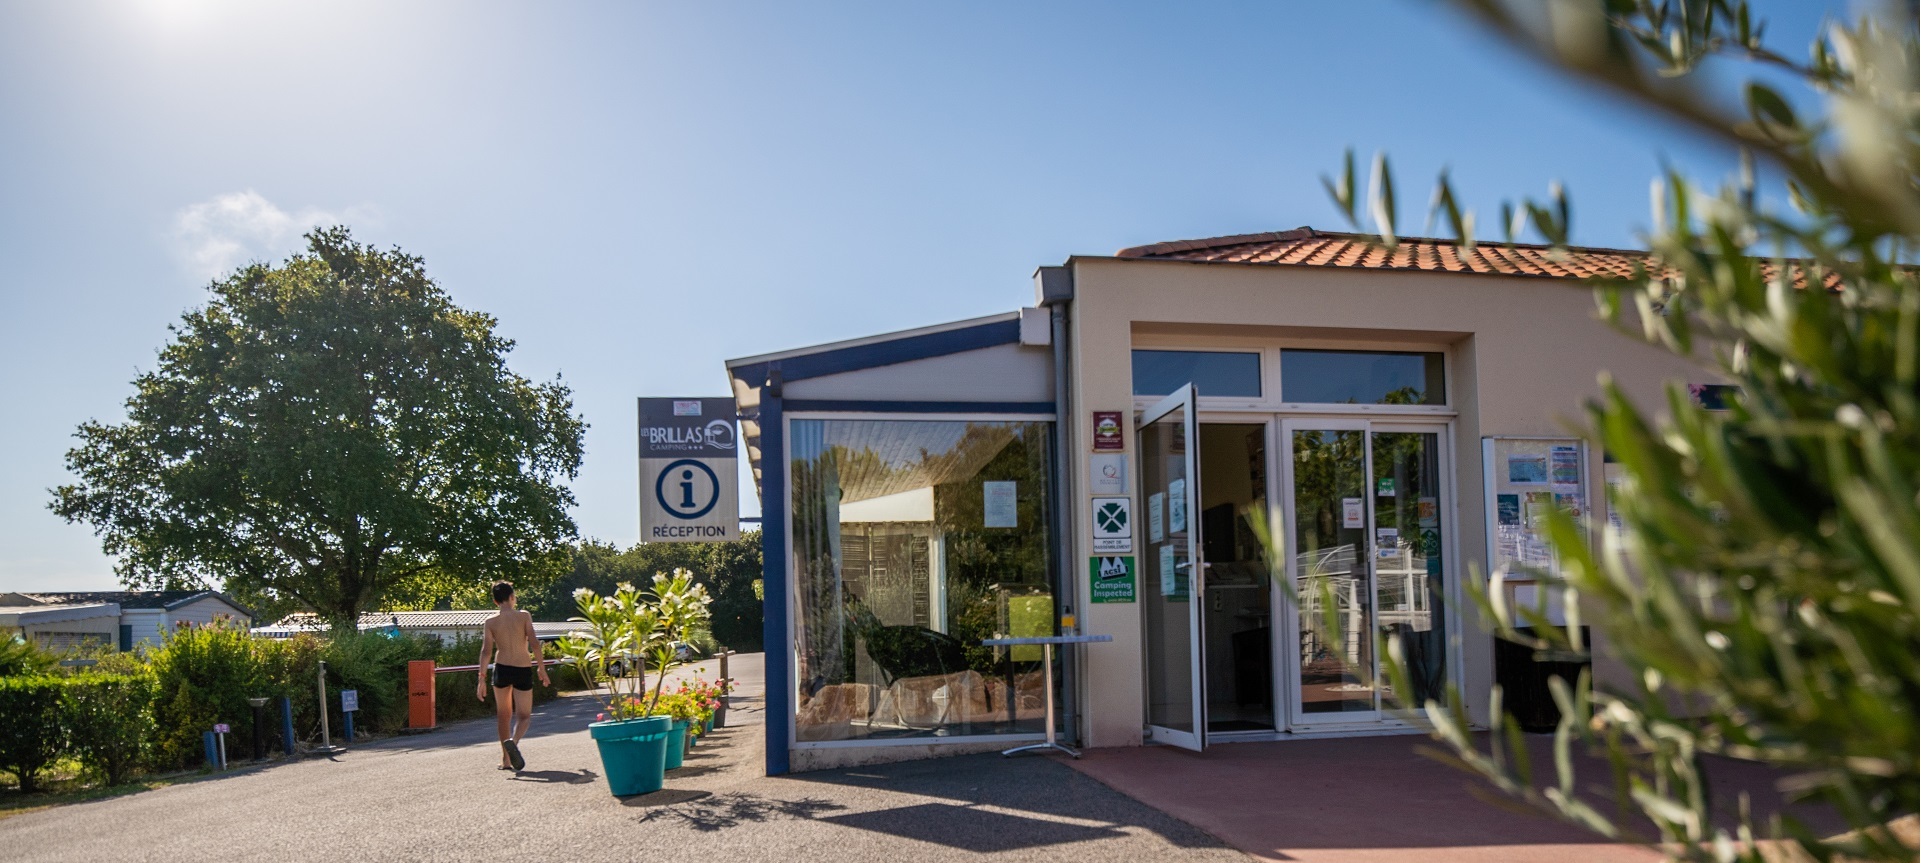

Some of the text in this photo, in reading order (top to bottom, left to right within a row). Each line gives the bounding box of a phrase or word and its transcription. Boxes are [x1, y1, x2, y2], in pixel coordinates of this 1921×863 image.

[650, 427, 703, 443] BRILLAS
[653, 524, 726, 538] RÉCEPTION
[1094, 581, 1132, 590] Camping
[1093, 590, 1133, 599] Inspected
